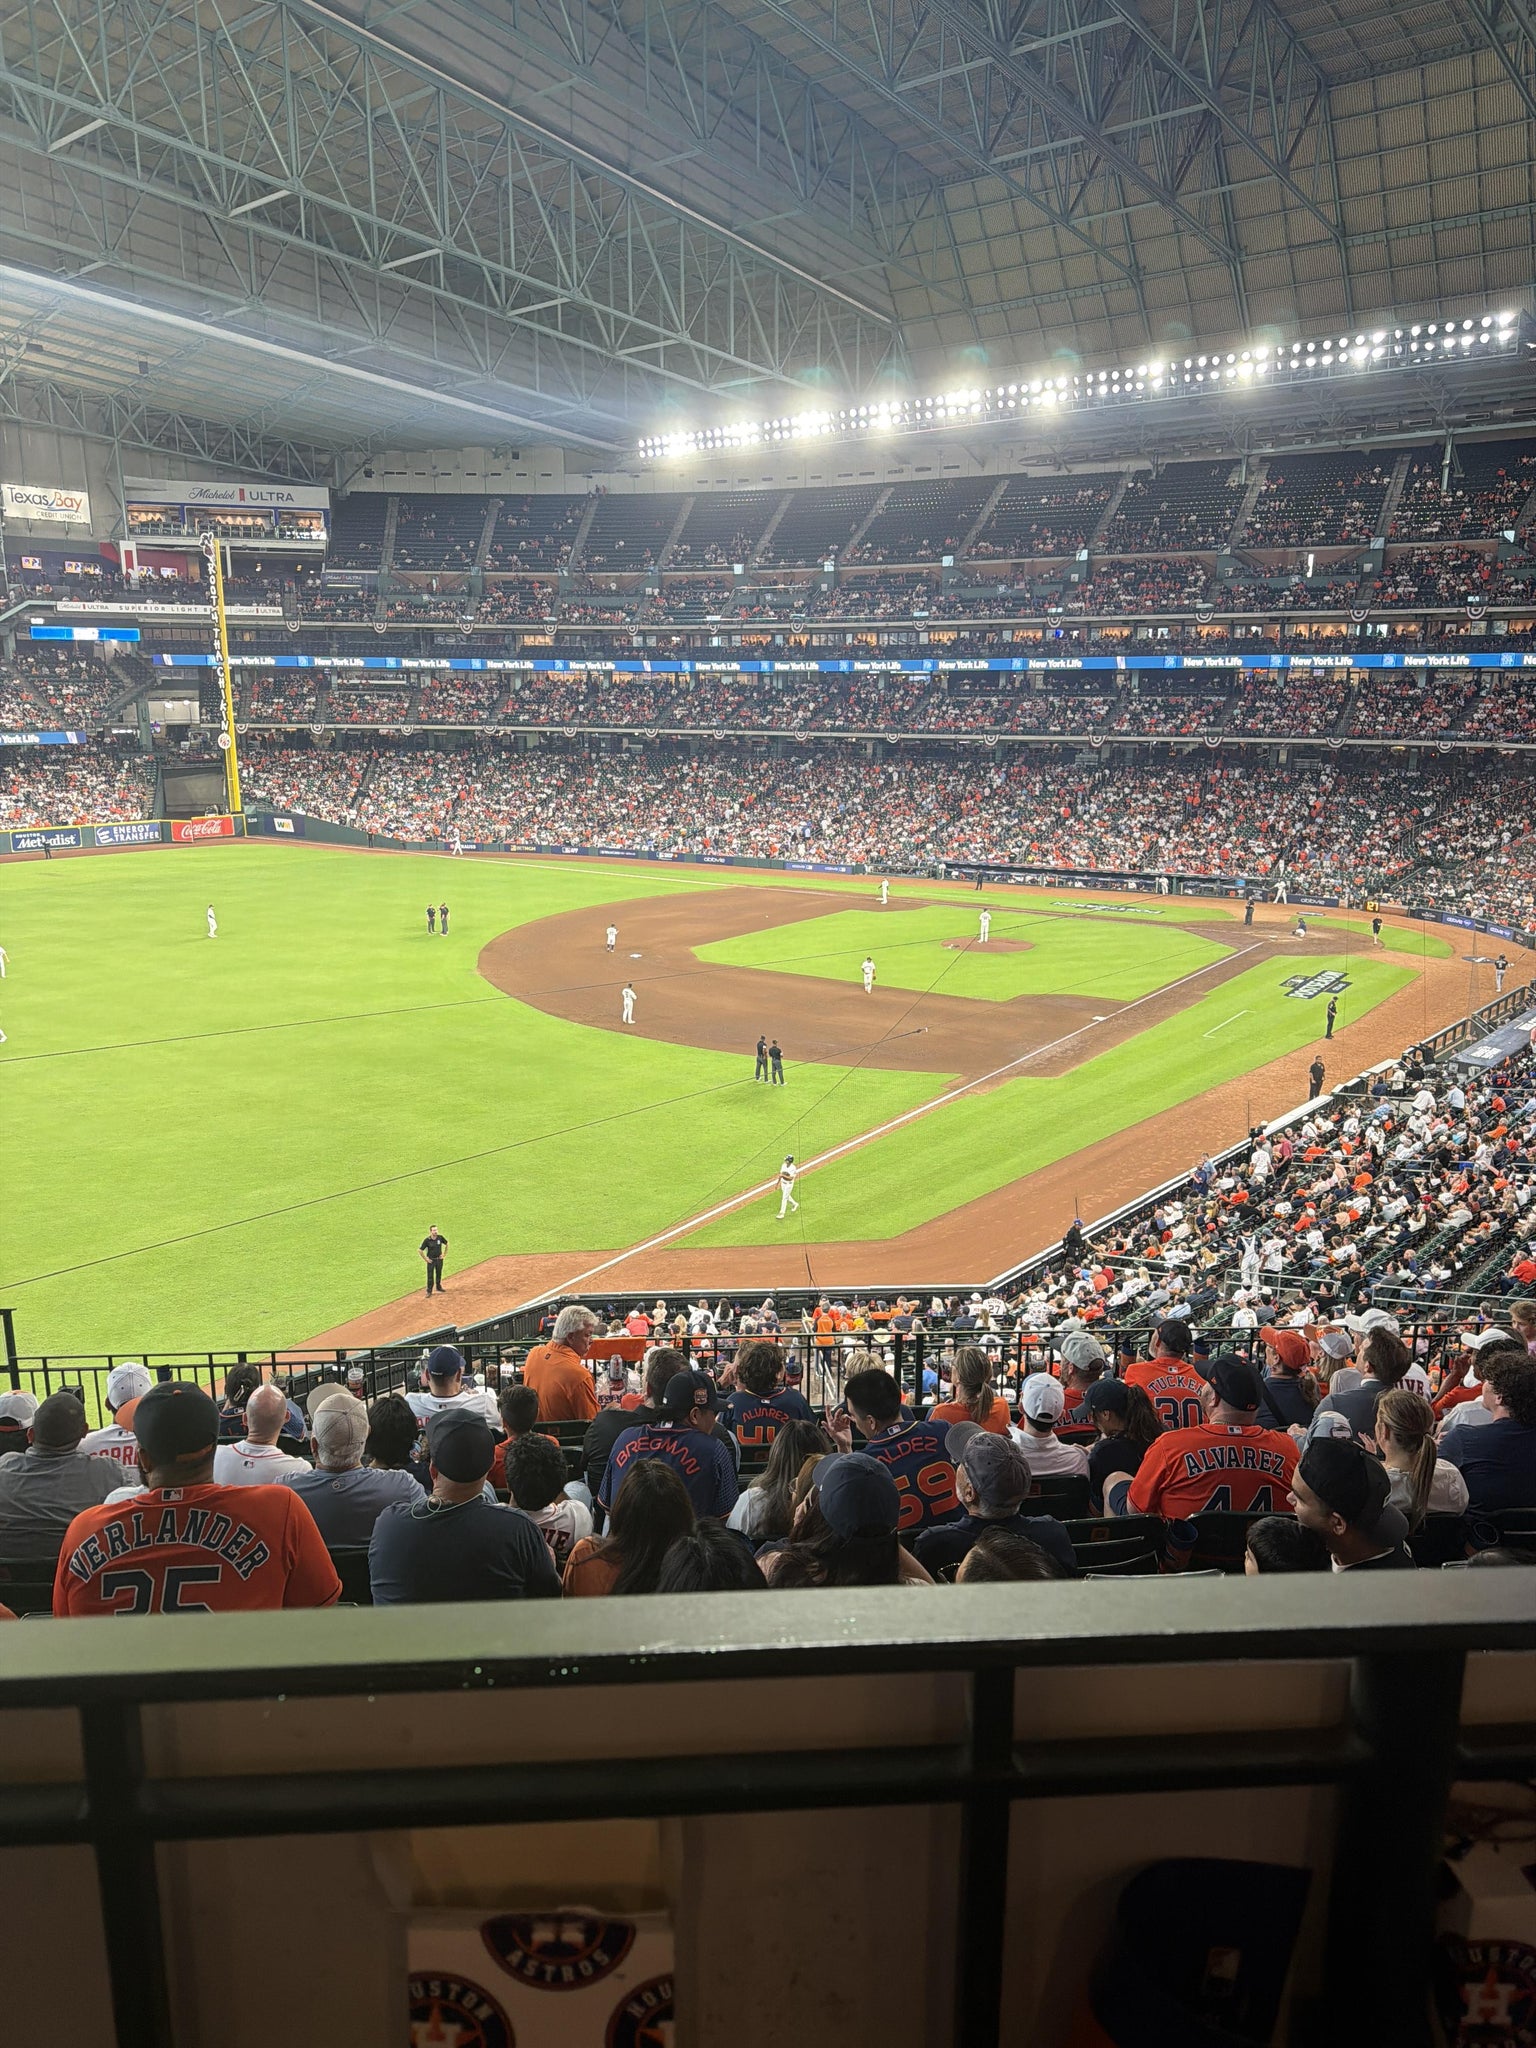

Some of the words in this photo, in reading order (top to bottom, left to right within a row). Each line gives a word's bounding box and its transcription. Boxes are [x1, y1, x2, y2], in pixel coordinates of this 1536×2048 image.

[7, 487, 48, 506] Texas
[54, 491, 82, 513] Bay
[188, 487, 235, 500] Michelob
[249, 491, 294, 502] ULTRA
[207, 563, 218, 609] ROOT
[213, 628, 223, 662] THA
[314, 658, 333, 666] New
[334, 658, 349, 666] York
[350, 658, 365, 666] Life
[402, 659, 418, 667] New
[419, 659, 435, 667] York
[436, 660, 450, 668] Life
[487, 660, 503, 668] New
[503, 660, 518, 668] York
[519, 661, 534, 669] Life
[570, 661, 585, 669] New
[585, 661, 600, 669] York
[601, 661, 615, 669] Life
[854, 661, 870, 669] New
[870, 662, 886, 670] York
[887, 662, 901, 670] Life
[938, 661, 955, 669] New
[956, 661, 972, 669] York
[973, 661, 989, 669] Life
[1029, 660, 1046, 668] New
[1046, 660, 1064, 668] York
[1064, 660, 1082, 668] Life
[1183, 658, 1203, 667] New
[1203, 658, 1224, 667] York
[1225, 658, 1243, 667] Life
[1290, 657, 1311, 666] New
[1312, 657, 1333, 666] York
[1334, 656, 1353, 666] Life
[1404, 656, 1426, 665] New
[1426, 656, 1450, 665] York
[1450, 656, 1469, 665] Life
[1523, 655, 1536, 665] Ne
[695, 662, 710, 670] New
[711, 662, 726, 670] York
[727, 662, 740, 670] Life
[774, 662, 789, 670] New
[790, 662, 805, 670] York
[806, 662, 819, 670] Life
[217, 666, 229, 731] CHIKIN
[113, 825, 150, 835] ENERGY
[114, 831, 160, 843] TRANSFER
[988, 1304, 1001, 1315] 27
[742, 1407, 790, 1424] ALVAREZ
[1154, 1395, 1204, 1428] 30
[615, 1436, 701, 1475] BREGMAN
[876, 1436, 938, 1465] ALDEZ
[1184, 1445, 1286, 1478] ALVAREZ
[68, 1507, 270, 1583] VERLANDER
[505, 1949, 611, 1982] ASTROS
[410, 1979, 495, 2022] USTON
[626, 1984, 672, 2018] HOU
